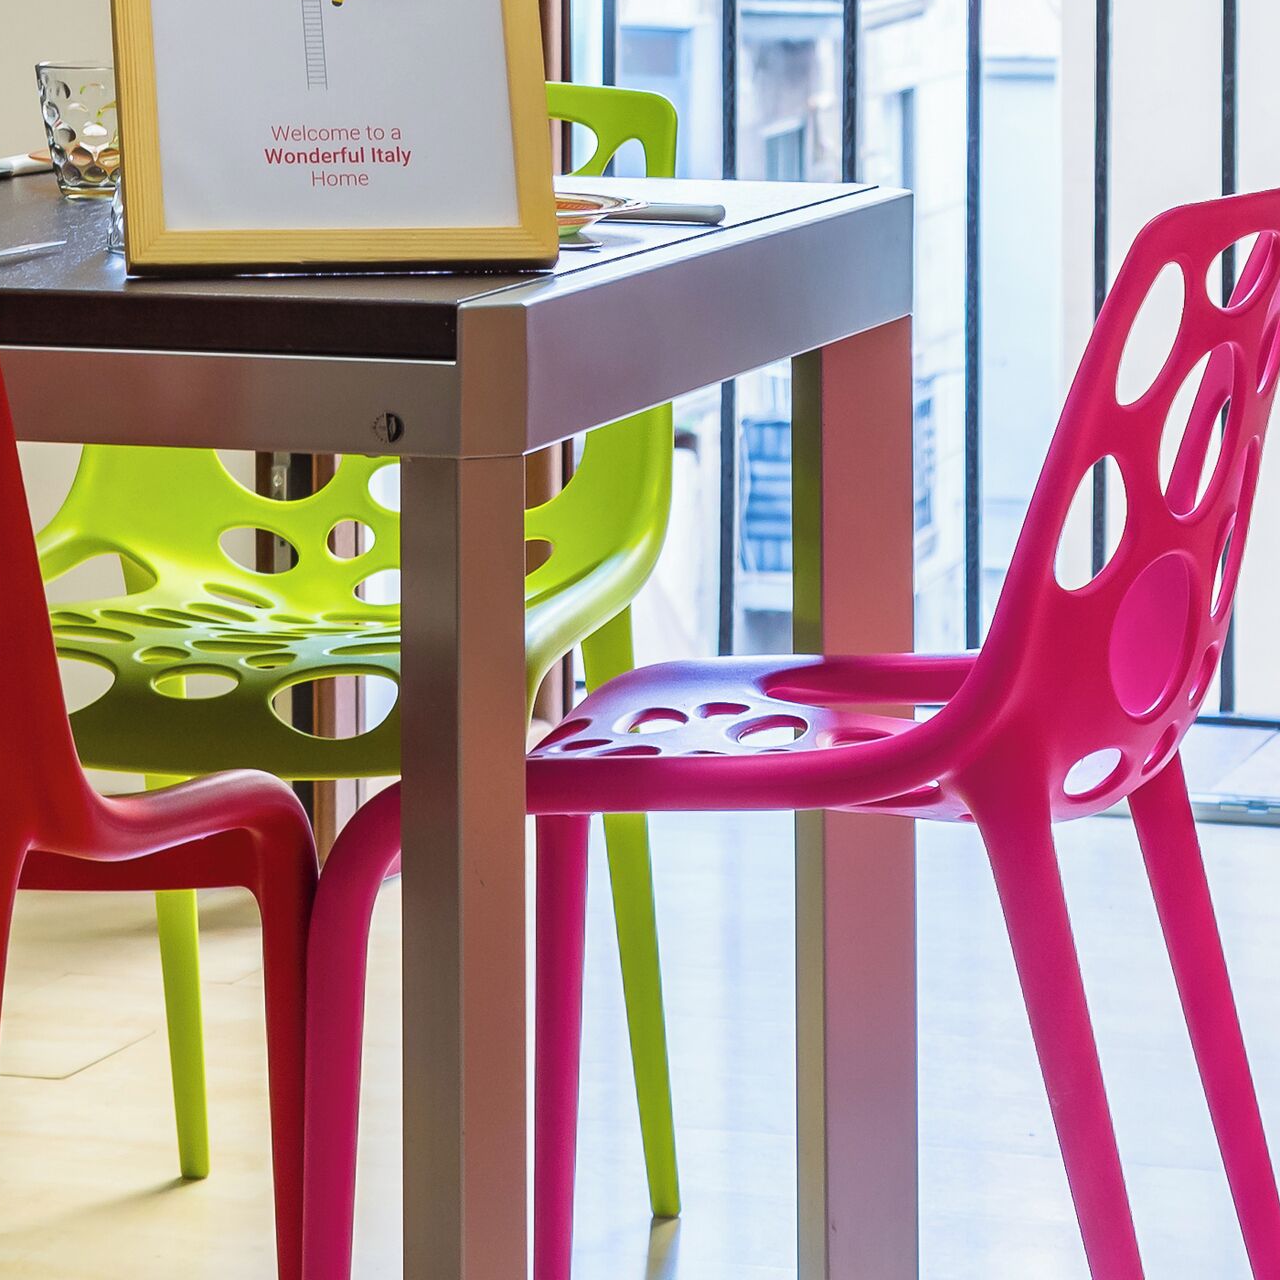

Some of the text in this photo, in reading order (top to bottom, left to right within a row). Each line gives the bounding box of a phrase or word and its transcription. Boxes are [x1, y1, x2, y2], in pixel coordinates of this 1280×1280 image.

[271, 125, 402, 141] Welcome to a
[264, 146, 412, 167] Wonderful Italy
[311, 171, 369, 187] Home
